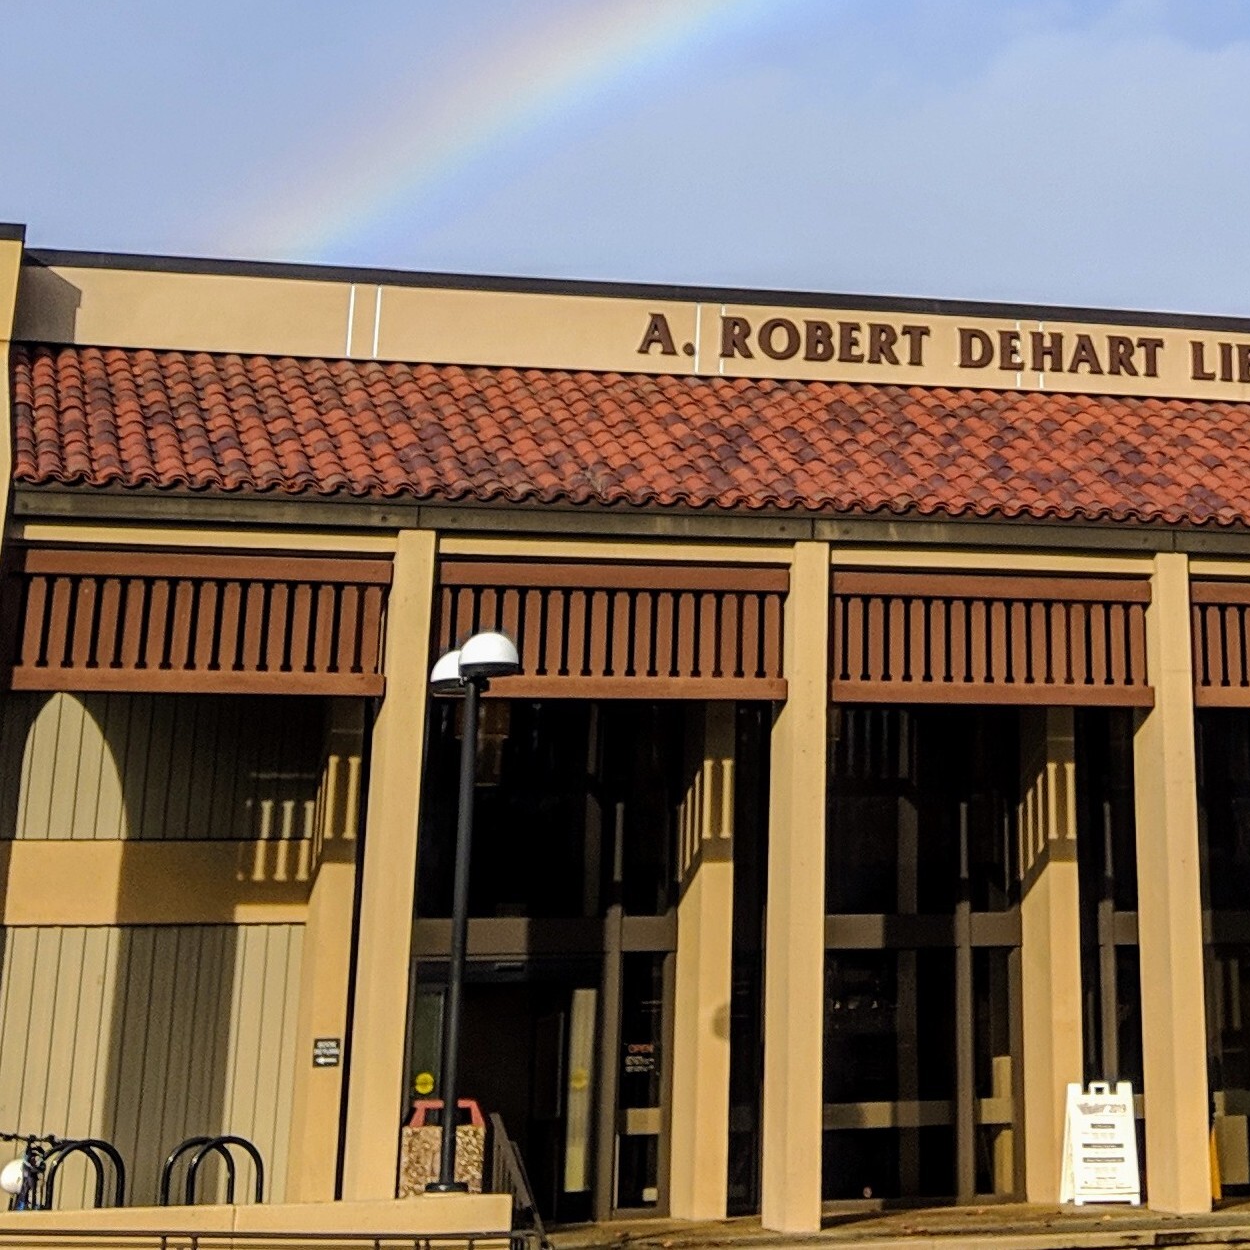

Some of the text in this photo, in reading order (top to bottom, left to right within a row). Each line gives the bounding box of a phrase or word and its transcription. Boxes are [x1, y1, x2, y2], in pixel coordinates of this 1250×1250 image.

[638, 312, 697, 357] A.
[719, 315, 931, 367] ROBERT
[958, 327, 1165, 378] DEHART
